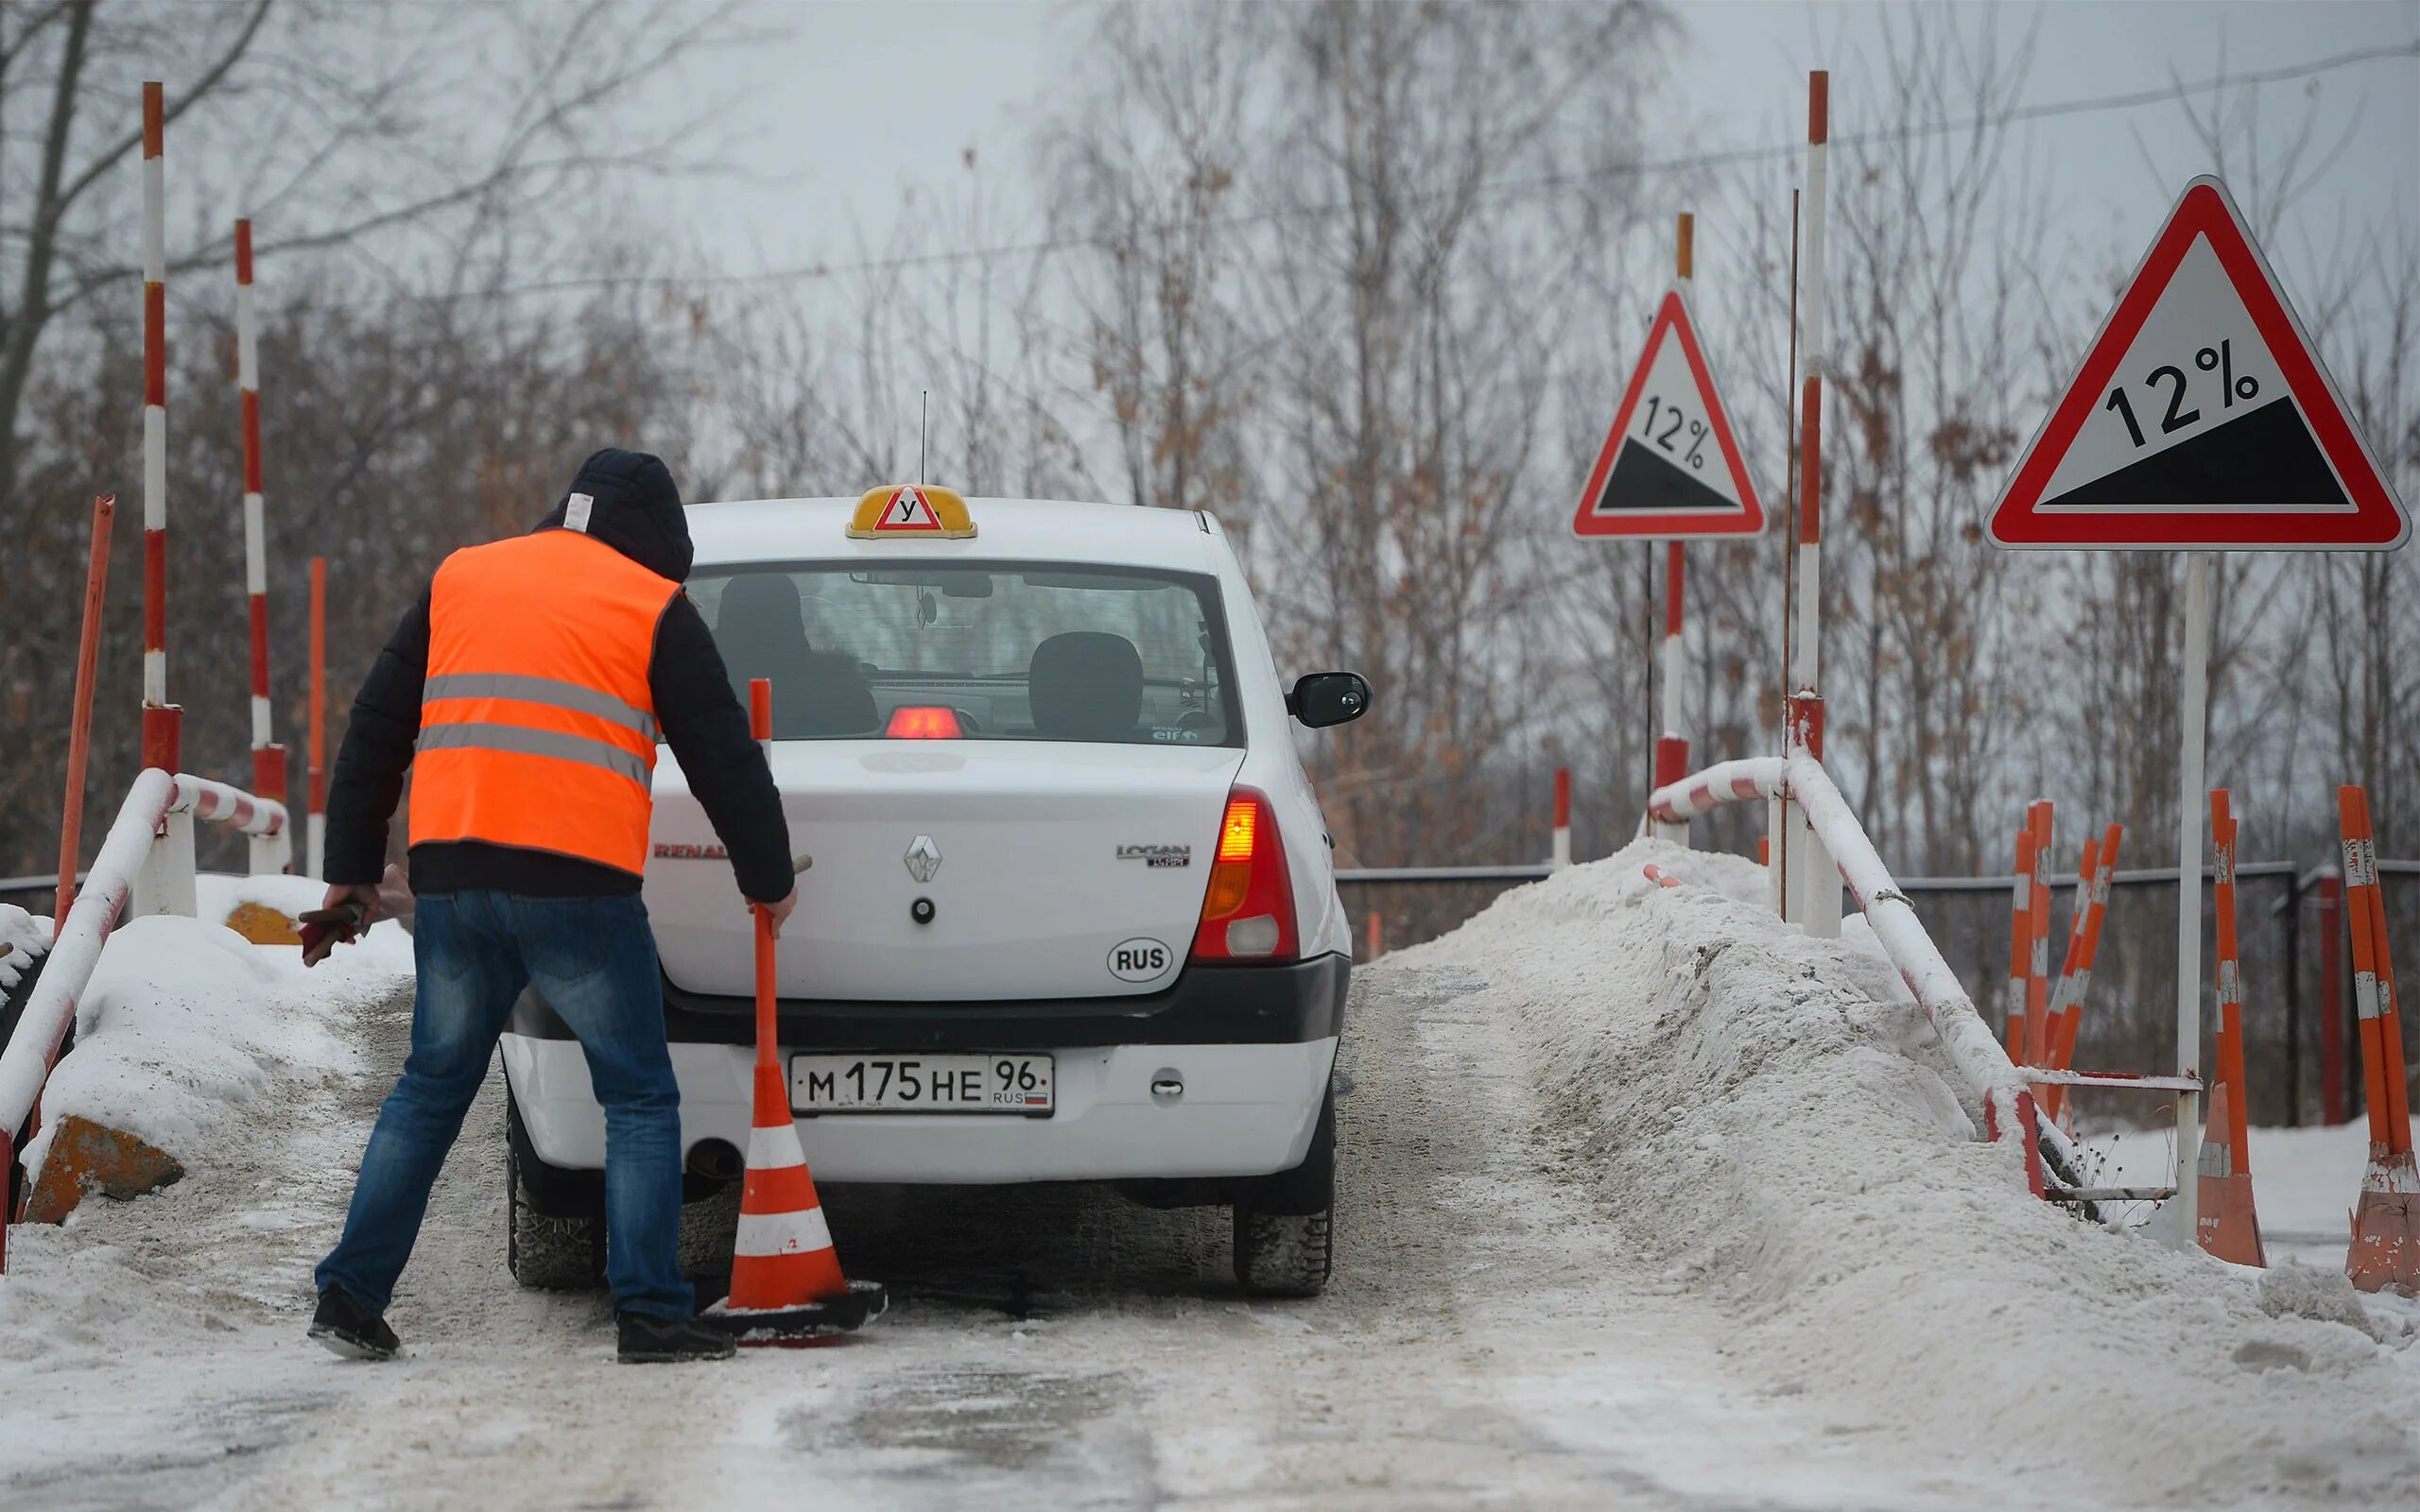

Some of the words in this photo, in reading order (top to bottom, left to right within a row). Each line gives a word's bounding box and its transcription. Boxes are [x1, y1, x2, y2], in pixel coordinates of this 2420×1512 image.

[2106, 338, 2259, 448] 12%
[1645, 396, 1709, 469] 12%
[1117, 948, 1164, 971] RUS
[995, 1060, 1036, 1091] 96
[994, 1092, 1024, 1104] RUS
